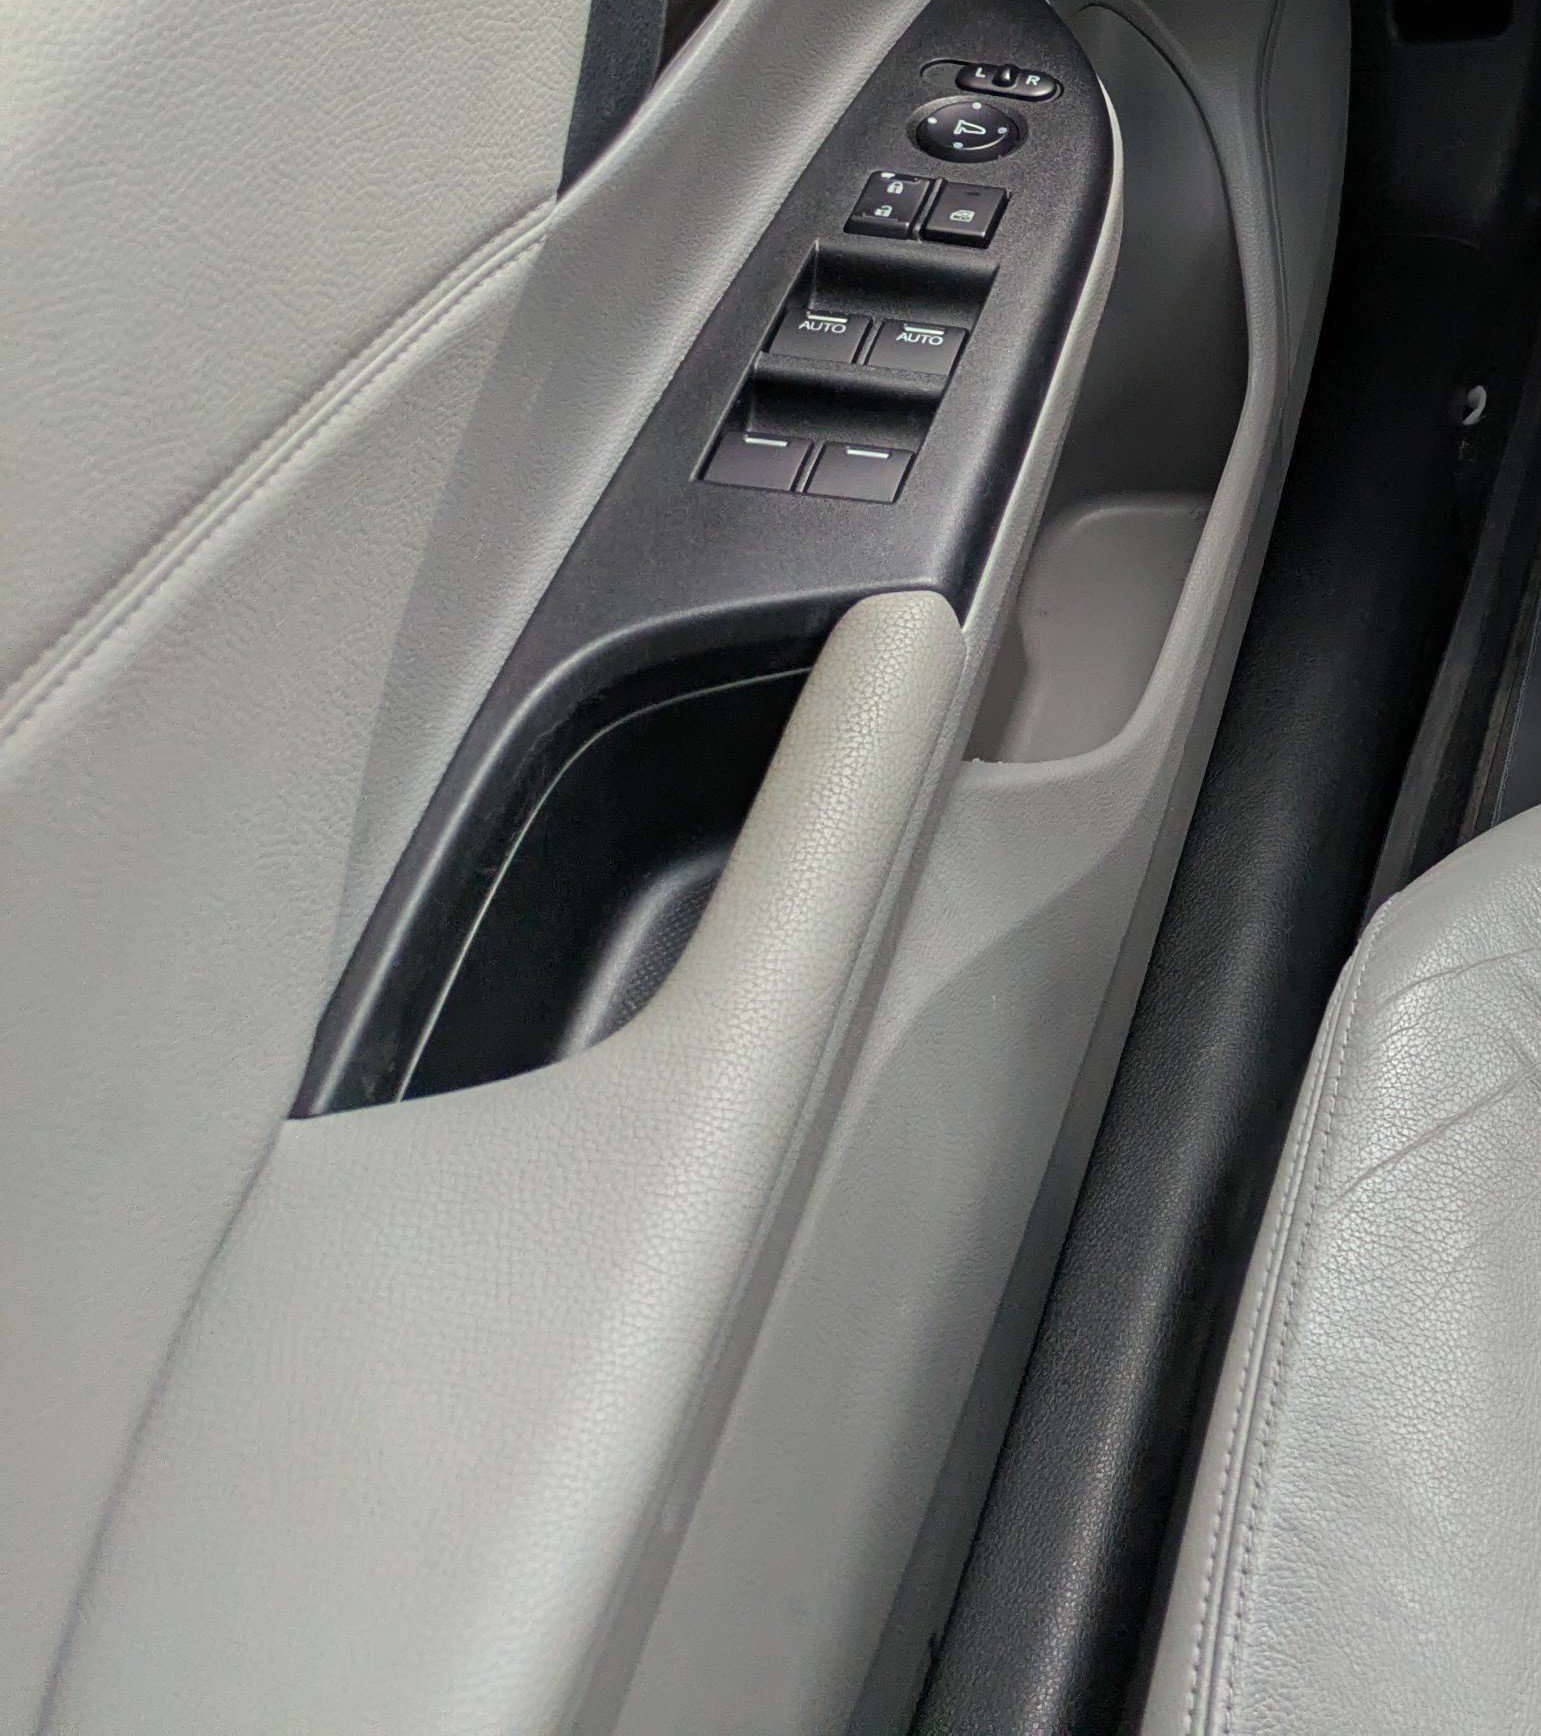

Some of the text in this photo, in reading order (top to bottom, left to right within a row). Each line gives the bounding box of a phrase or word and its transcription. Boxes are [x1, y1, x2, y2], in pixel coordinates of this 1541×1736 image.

[975, 67, 987, 79] L
[1026, 73, 1041, 87] R
[798, 319, 847, 335] AUTO
[896, 331, 944, 347] AUTO
